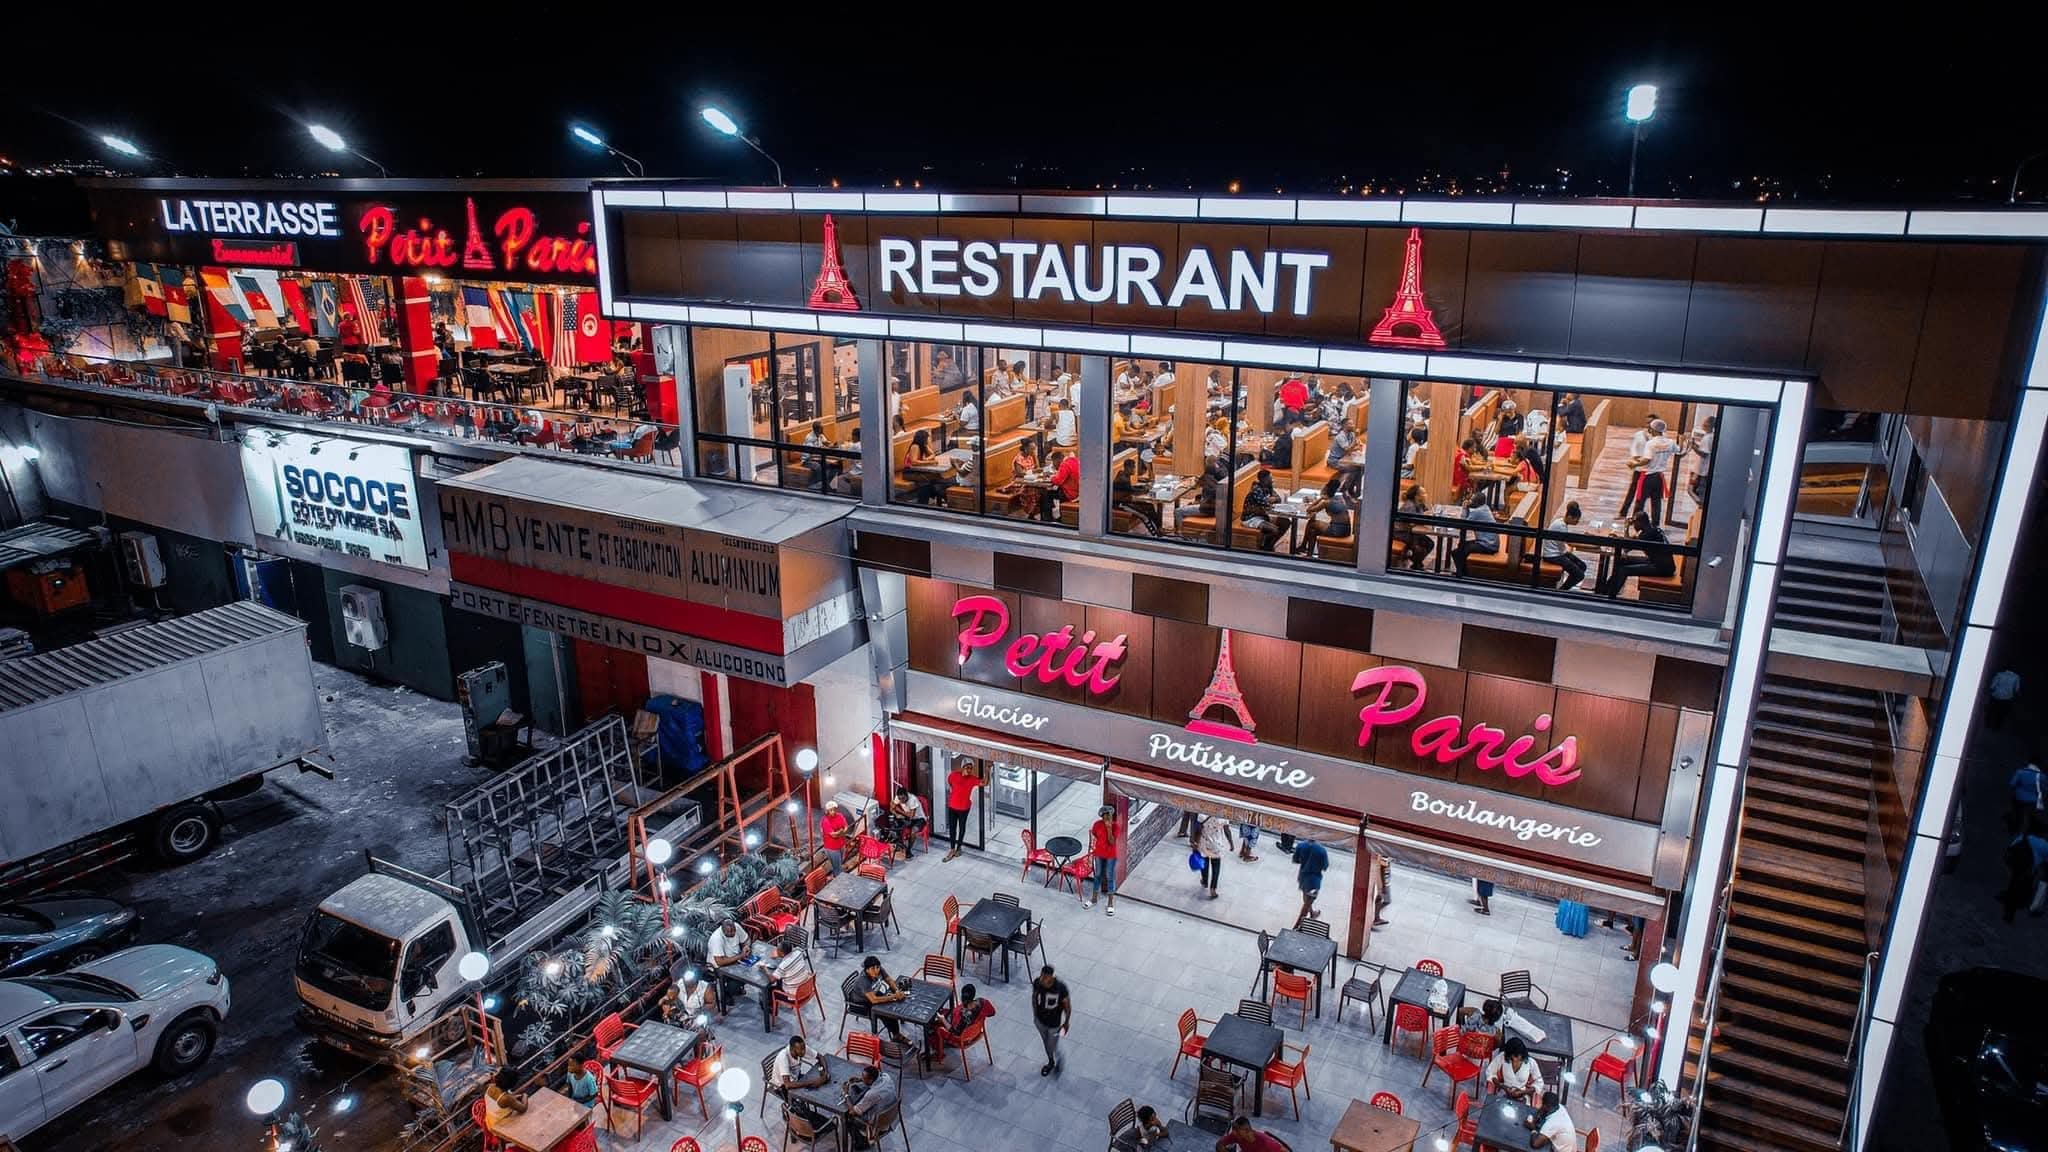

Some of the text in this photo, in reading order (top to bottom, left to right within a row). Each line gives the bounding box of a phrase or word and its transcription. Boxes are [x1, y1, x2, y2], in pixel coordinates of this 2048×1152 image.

[359, 205, 458, 266] Petit
[879, 238, 1329, 316] RESTAURANT
[283, 464, 411, 521] SOCOCE
[438, 493, 511, 551] HMB
[515, 516, 593, 560] VENTE
[597, 532, 611, 567] ET
[613, 535, 682, 581] FABRICATION
[691, 549, 780, 598] ALUMINIUM
[450, 588, 786, 682] PORTE FENETRE INOX ALUCOBOND
[951, 594, 1129, 695] Petit
[1350, 665, 1583, 787] Paris
[956, 694, 1049, 732] Glacier
[1149, 732, 1316, 790] Patisserie
[1409, 791, 1602, 849] Boulangerie
